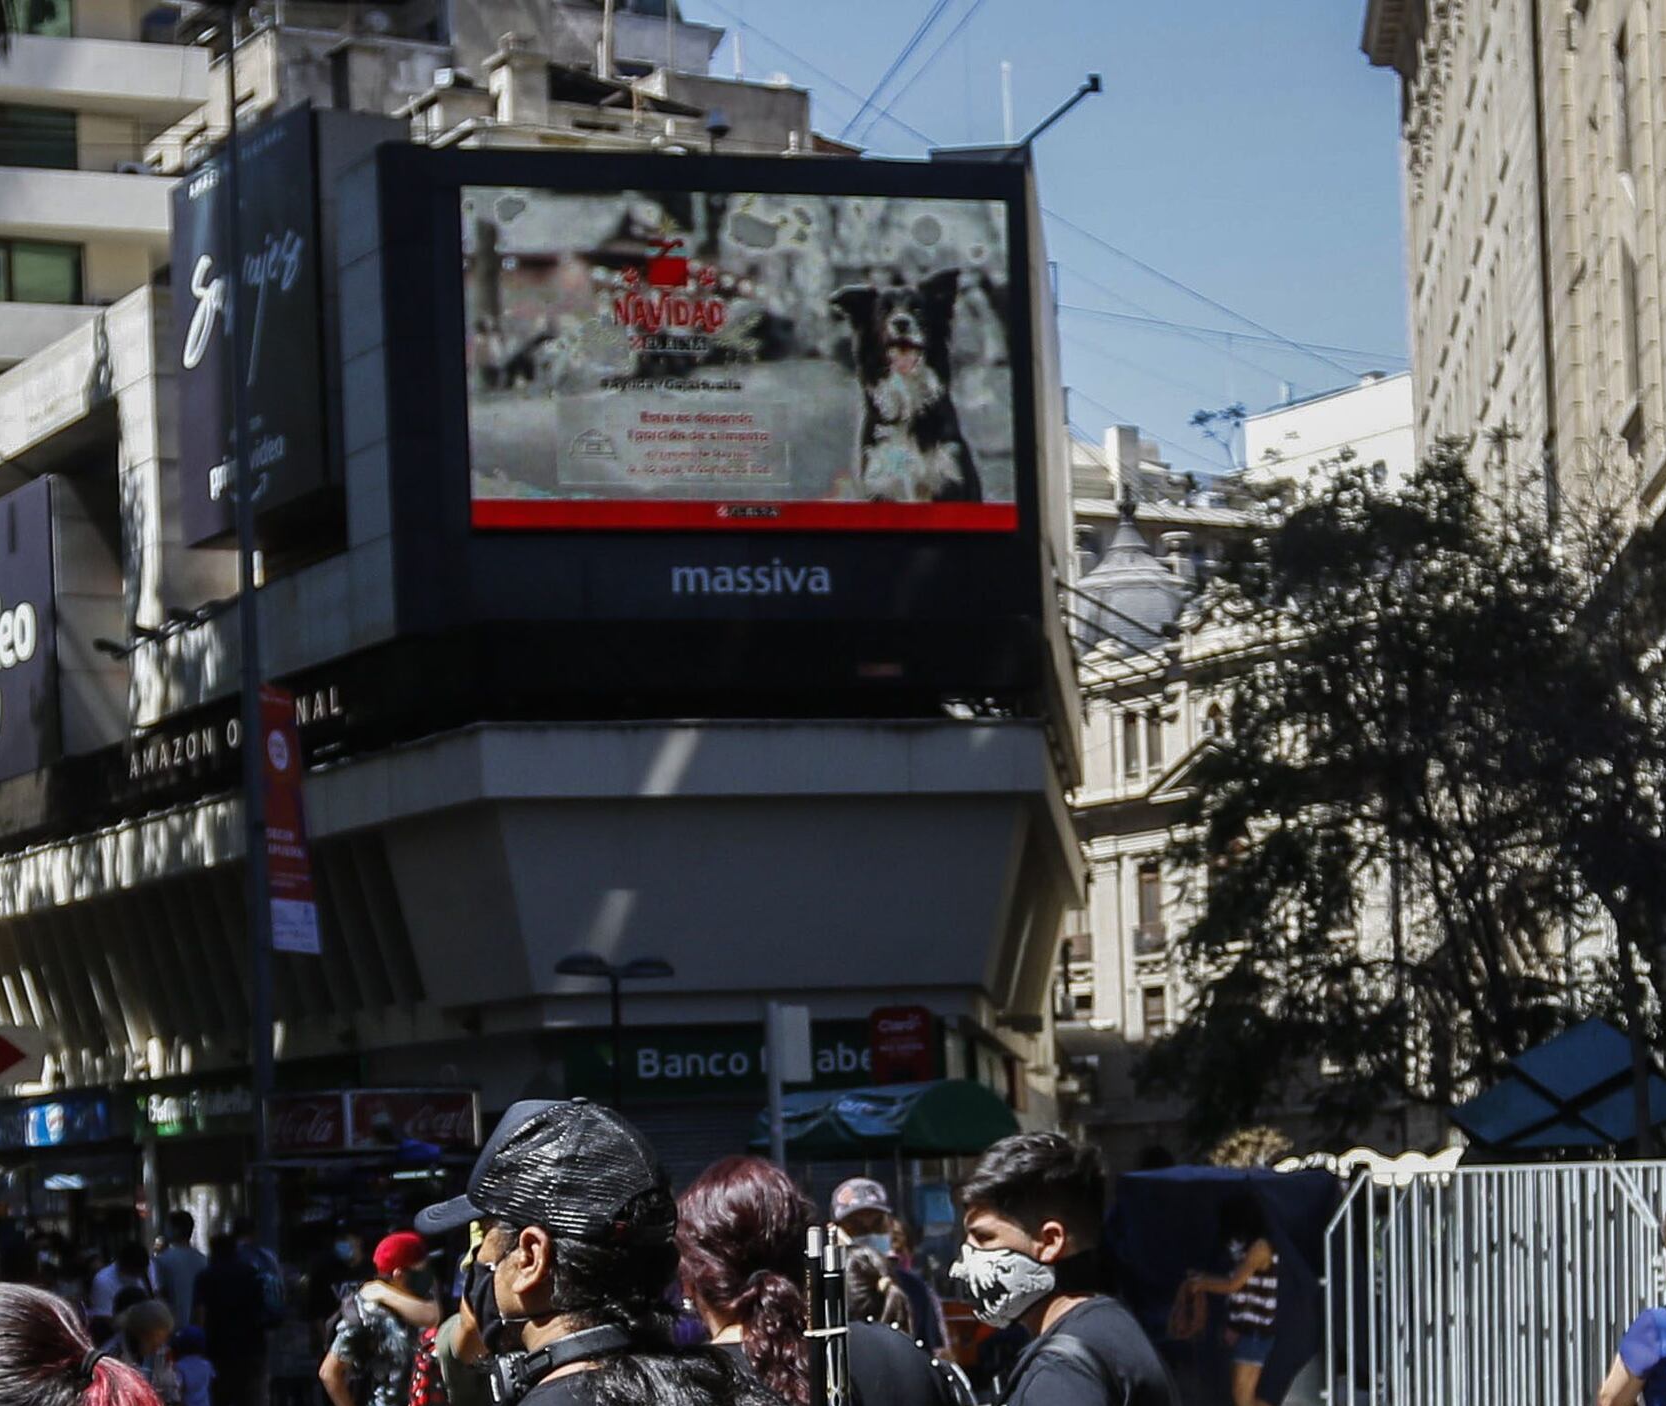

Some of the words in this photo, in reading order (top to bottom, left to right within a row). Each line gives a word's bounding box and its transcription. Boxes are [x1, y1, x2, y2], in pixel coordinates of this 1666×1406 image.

[614, 296, 725, 334] NAVIDAD
[671, 557, 831, 593] massiva
[129, 726, 214, 779] AMAZON
[637, 1047, 749, 1079] Banco
